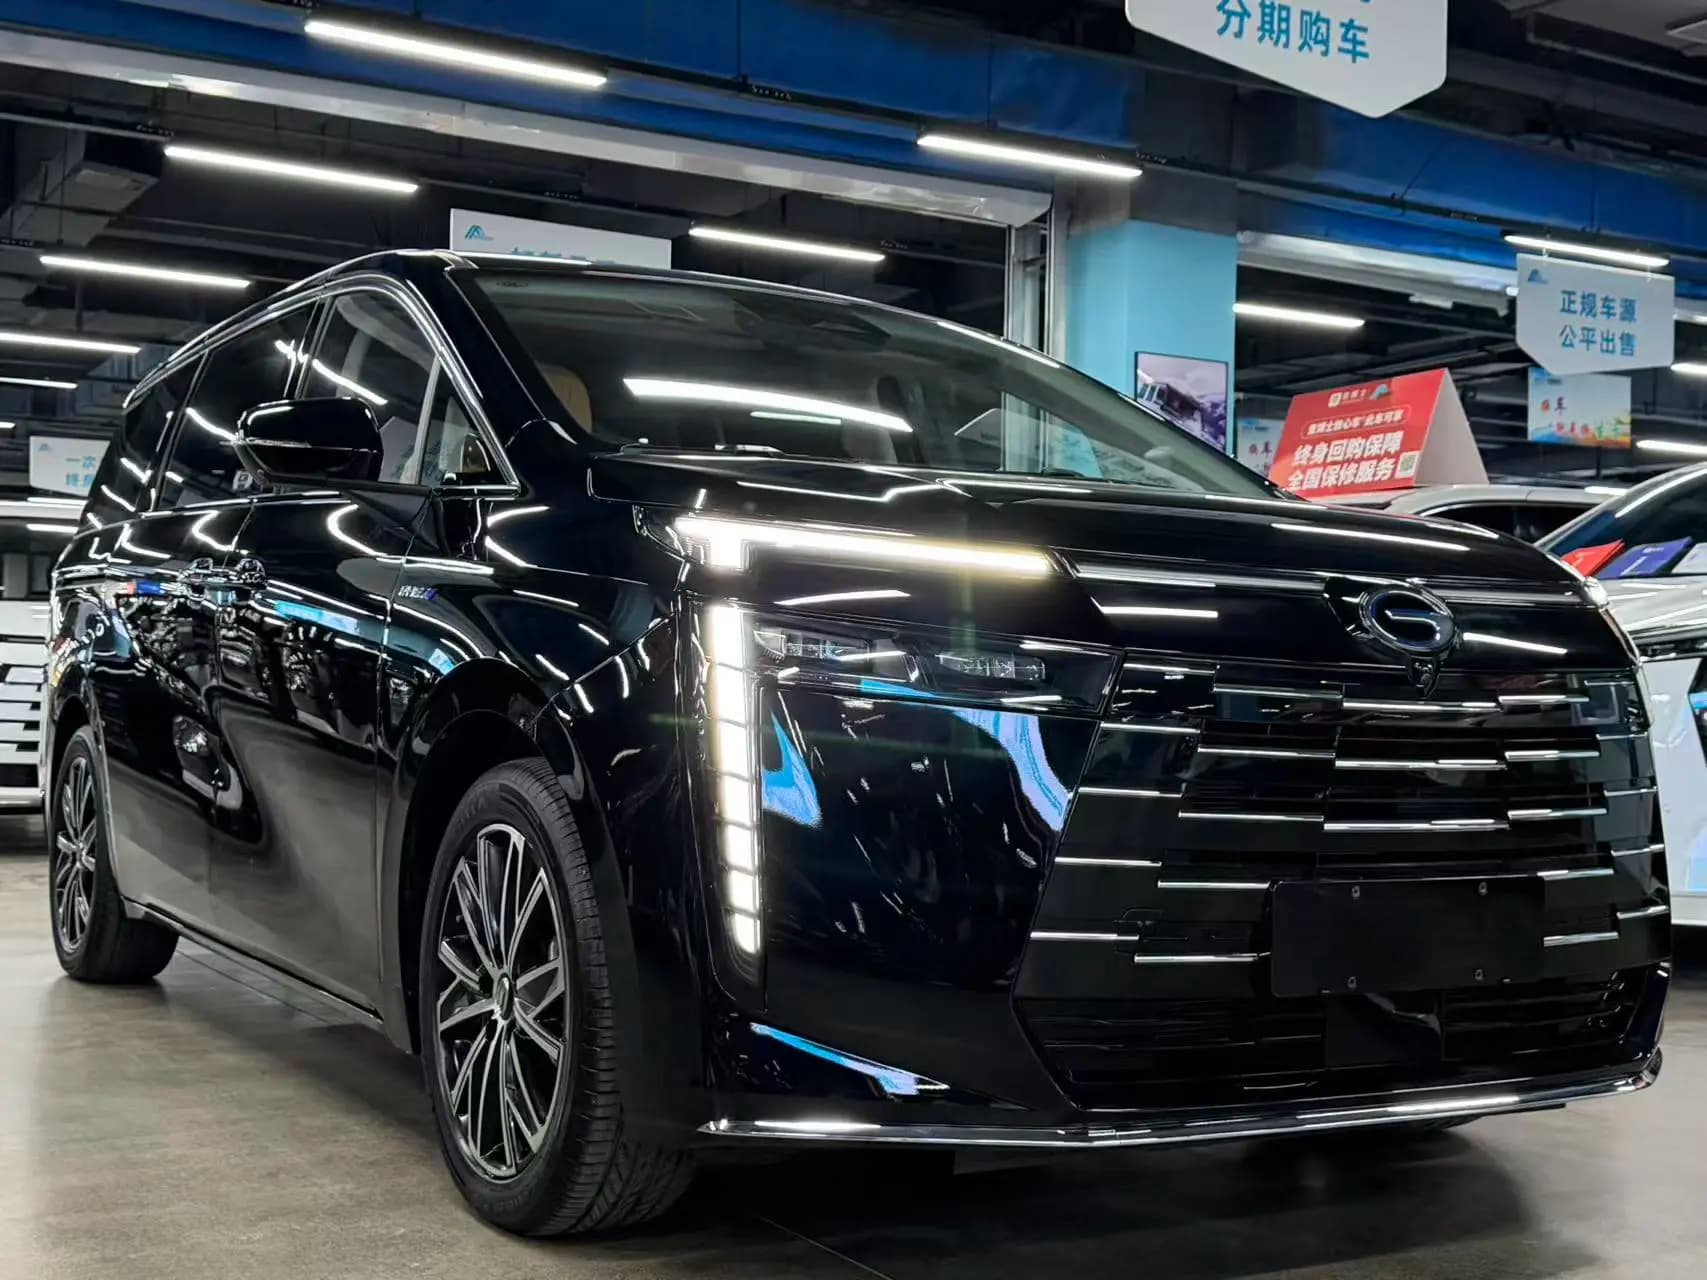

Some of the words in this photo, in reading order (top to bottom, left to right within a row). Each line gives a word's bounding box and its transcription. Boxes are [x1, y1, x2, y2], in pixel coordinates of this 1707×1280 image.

[1216, 0, 1369, 64] 分期购车
[1560, 290, 1637, 323] 正规车源
[1560, 324, 1636, 357] 公平出售
[1291, 431, 1404, 467] 终身回购保障
[1287, 457, 1396, 491] 全国保修服务
